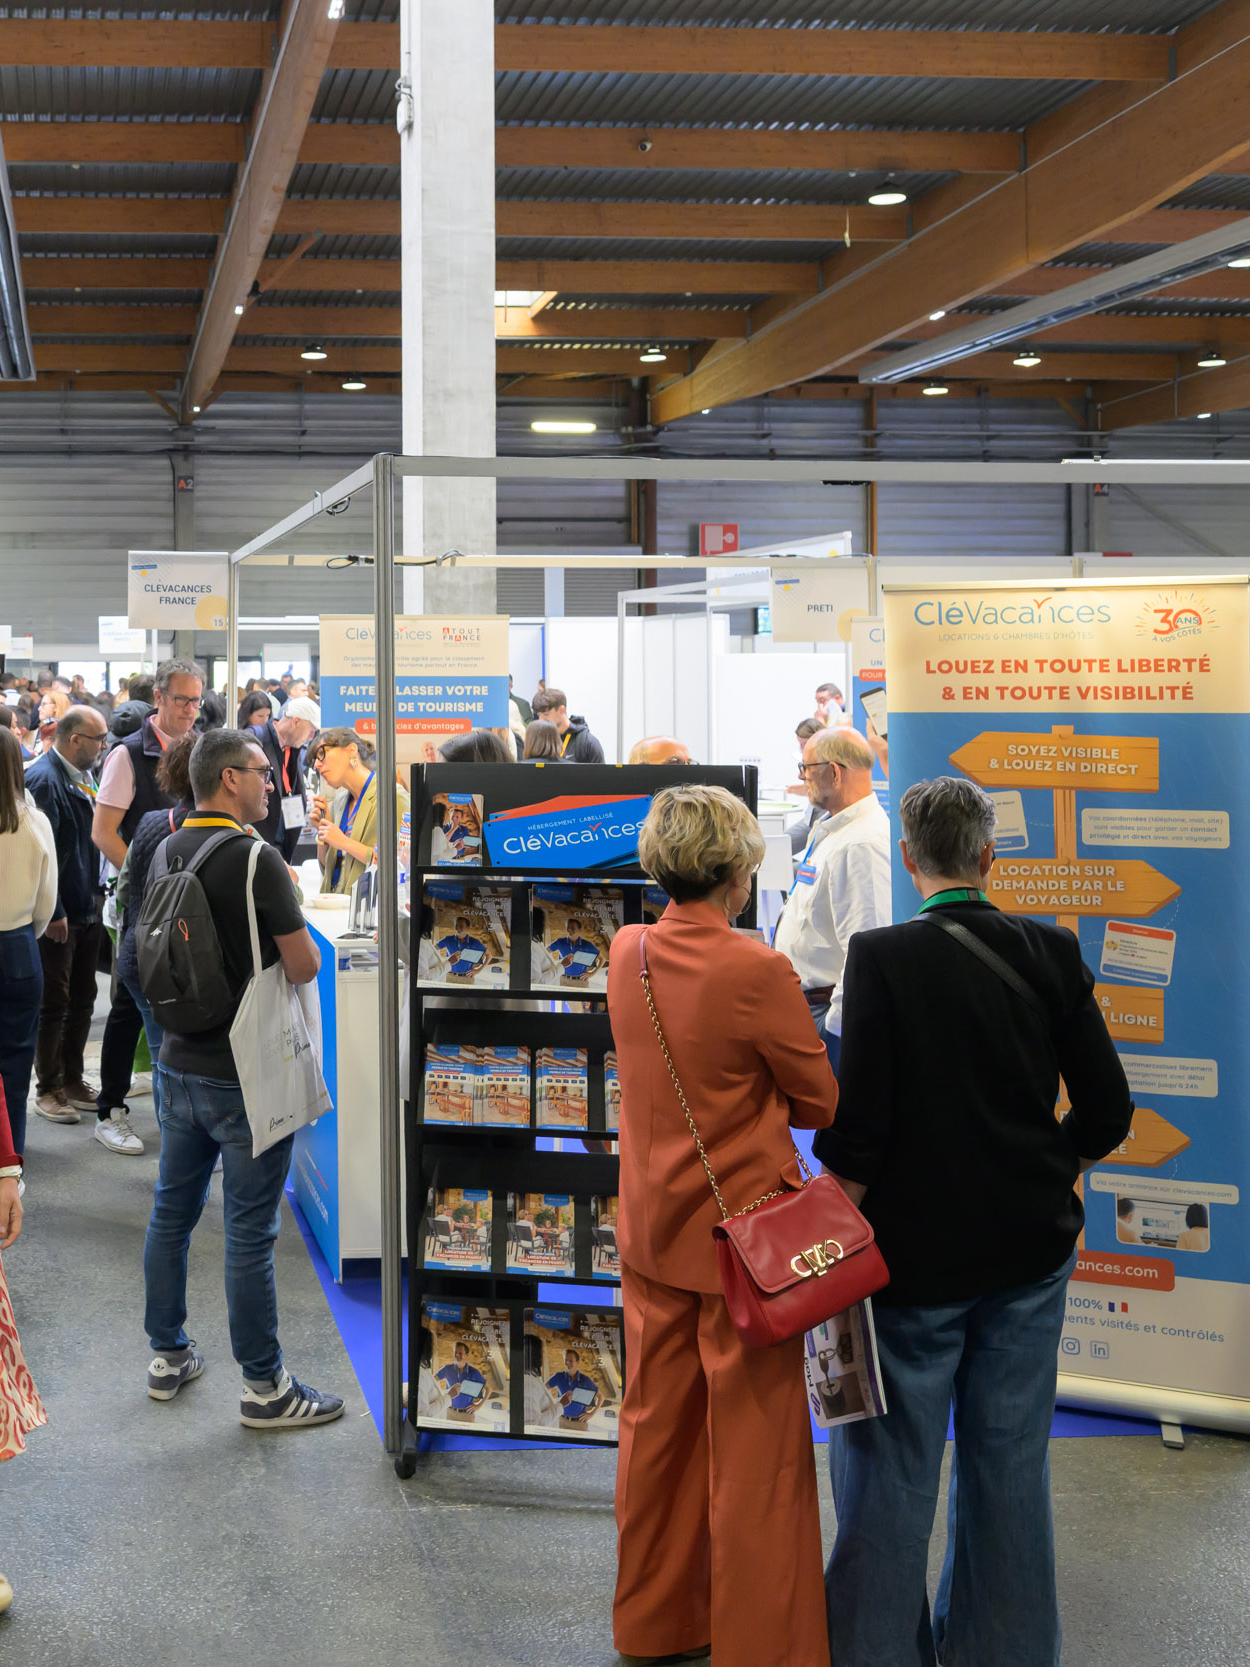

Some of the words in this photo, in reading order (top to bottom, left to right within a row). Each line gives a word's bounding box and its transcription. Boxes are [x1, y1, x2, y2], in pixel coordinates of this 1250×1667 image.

[178, 479, 194, 489] A2
[159, 597, 197, 605] FRANCE
[807, 604, 834, 612] PRETI
[914, 597, 1111, 626] CléVacances
[214, 619, 224, 627] 15
[1153, 608, 1203, 635] 30
[1175, 616, 1200, 625] ANS
[869, 628, 885, 642] Cl
[938, 632, 991, 641] LOCATIONS
[1002, 632, 1050, 640] CHAMBRES
[1053, 630, 1095, 640] D'HÔTES
[1160, 634, 1176, 643] VOS
[1177, 627, 1202, 638] CÔTÉS
[925, 659, 995, 674] LOUEZ
[1001, 659, 1029, 674] EN
[1034, 659, 1111, 673] TOUTE
[1117, 653, 1211, 673] LIBERTÉ
[861, 671, 883, 679] POUR
[340, 686, 376, 696] FAITE
[396, 686, 443, 696] LASSER
[446, 686, 489, 696] VOTRE
[941, 686, 956, 701] &
[962, 686, 990, 700] EN
[995, 686, 1071, 700] TOUTE
[1076, 681, 1194, 701] VISIBILITÉ
[345, 702, 376, 712] MEU
[398, 702, 414, 712] DE
[418, 702, 484, 712] TOURISME
[414, 721, 464, 731] d'avantages
[1007, 744, 1058, 757] SOYEZ
[1061, 746, 1120, 759] VISIBLE
[989, 758, 999, 769] &
[1003, 759, 1053, 771] LOUEZ
[1056, 761, 1077, 772] EN
[1080, 762, 1139, 775] DIRECT
[527, 818, 577, 831] HÉBERGEMENT
[578, 811, 614, 823] LABELLISÉ
[1154, 825, 1177, 833] garder
[999, 865, 1081, 876] LOCATION
[1084, 865, 1116, 876] SUR
[992, 880, 1069, 891] DEMANDE
[1072, 880, 1103, 891] PAR
[1107, 881, 1125, 891] LE
[1015, 894, 1103, 906] VOYAGEUR
[1101, 996, 1110, 1007] &
[1110, 1011, 1158, 1027] LIGNE
[1124, 1061, 1177, 1070] commercialisez
[1179, 1064, 1213, 1072] librement
[1126, 1069, 1167, 1078] ébergement
[1128, 1183, 1158, 1191] annonce
[1172, 1187, 1233, 1198] clevacances.com
[1076, 1260, 1159, 1278] ances.com
[1068, 1296, 1103, 1311] 100%
[1099, 1317, 1140, 1332] visités
[1143, 1324, 1157, 1334] et
[1161, 1325, 1225, 1343] contrôlés
